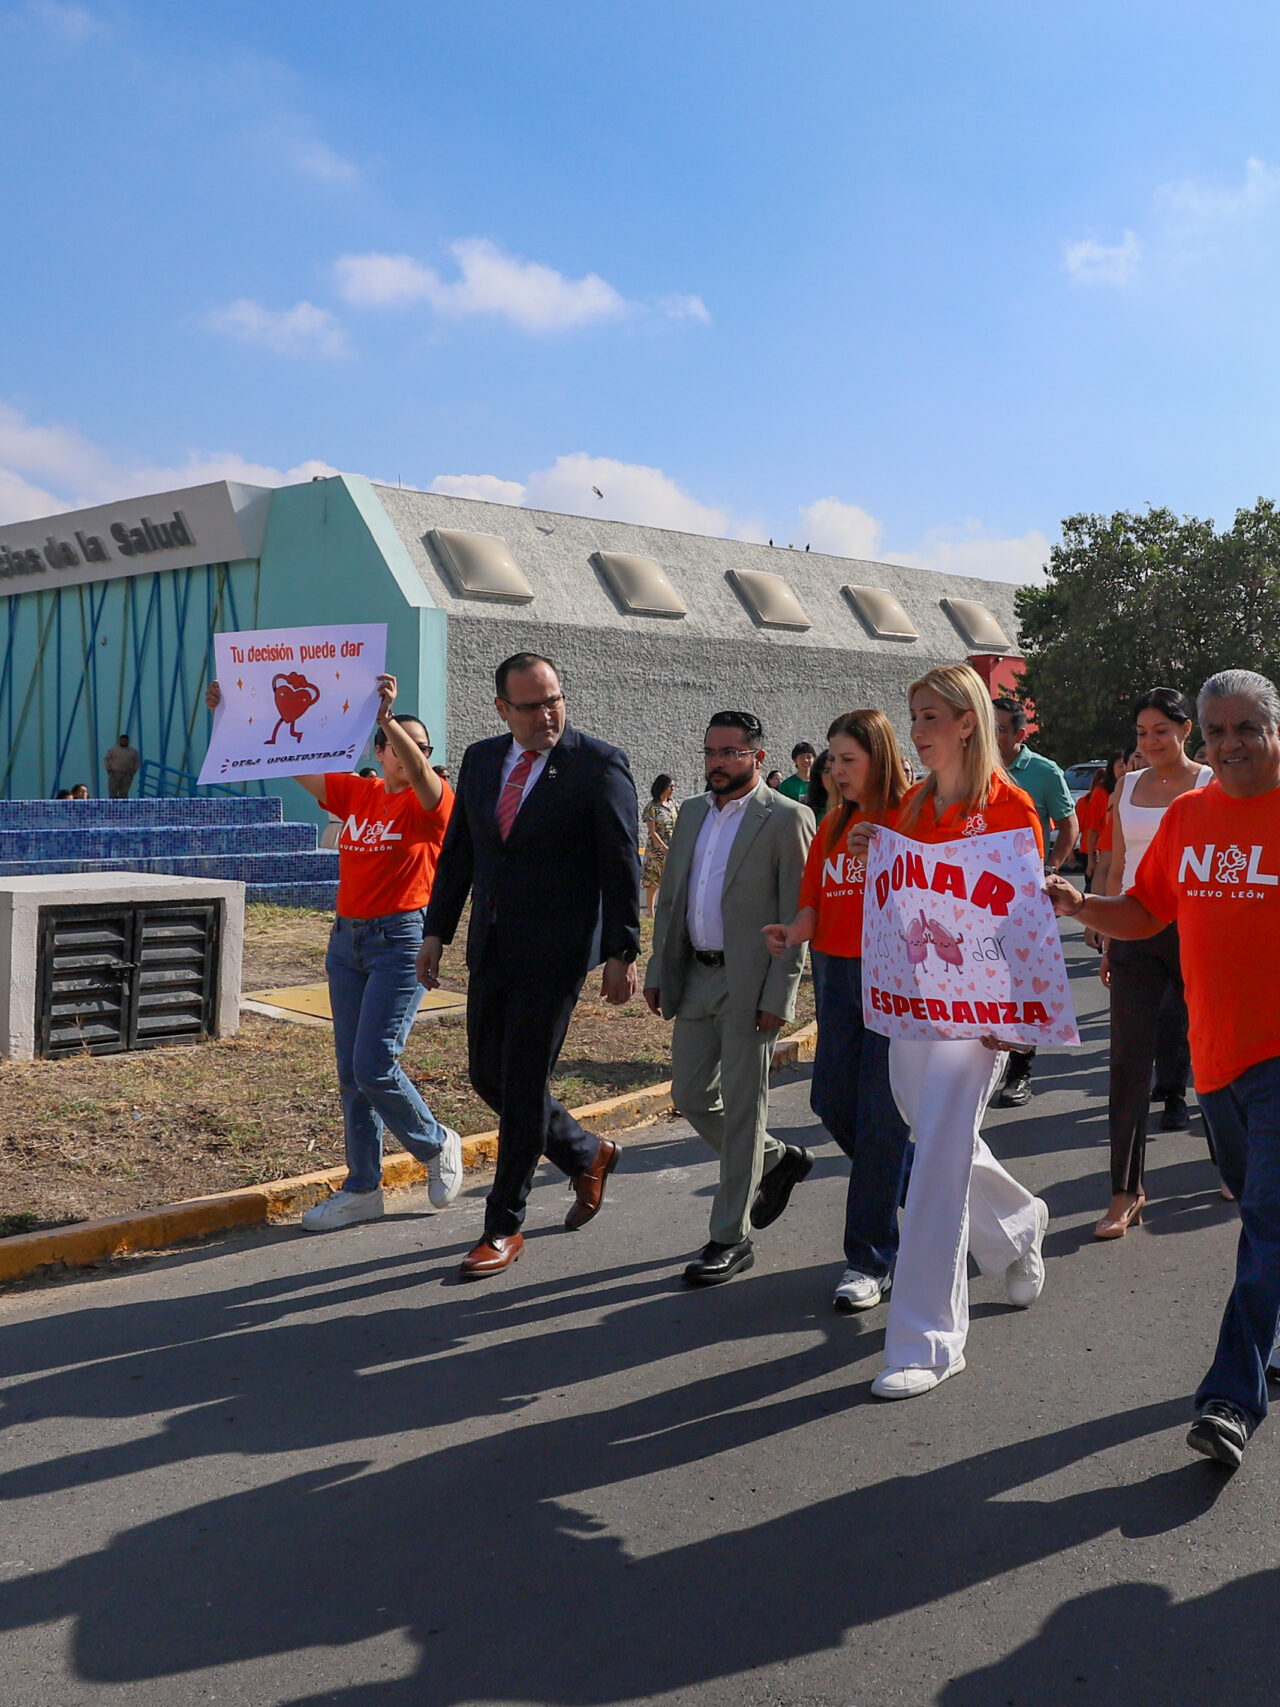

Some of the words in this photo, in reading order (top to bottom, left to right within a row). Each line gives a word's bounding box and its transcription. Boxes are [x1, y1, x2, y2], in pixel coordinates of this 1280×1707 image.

[74, 530, 111, 563] la
[110, 510, 196, 557] Salud
[230, 646, 244, 664] Tu
[247, 643, 294, 663] decisión
[300, 640, 336, 664] puede
[340, 640, 364, 658] dar
[875, 851, 1016, 917] DONAR
[1186, 890, 1223, 898] NUEVO
[1231, 890, 1265, 899] LEÓN
[972, 935, 1007, 962] dar
[871, 986, 1050, 1025] ESPERANZA
